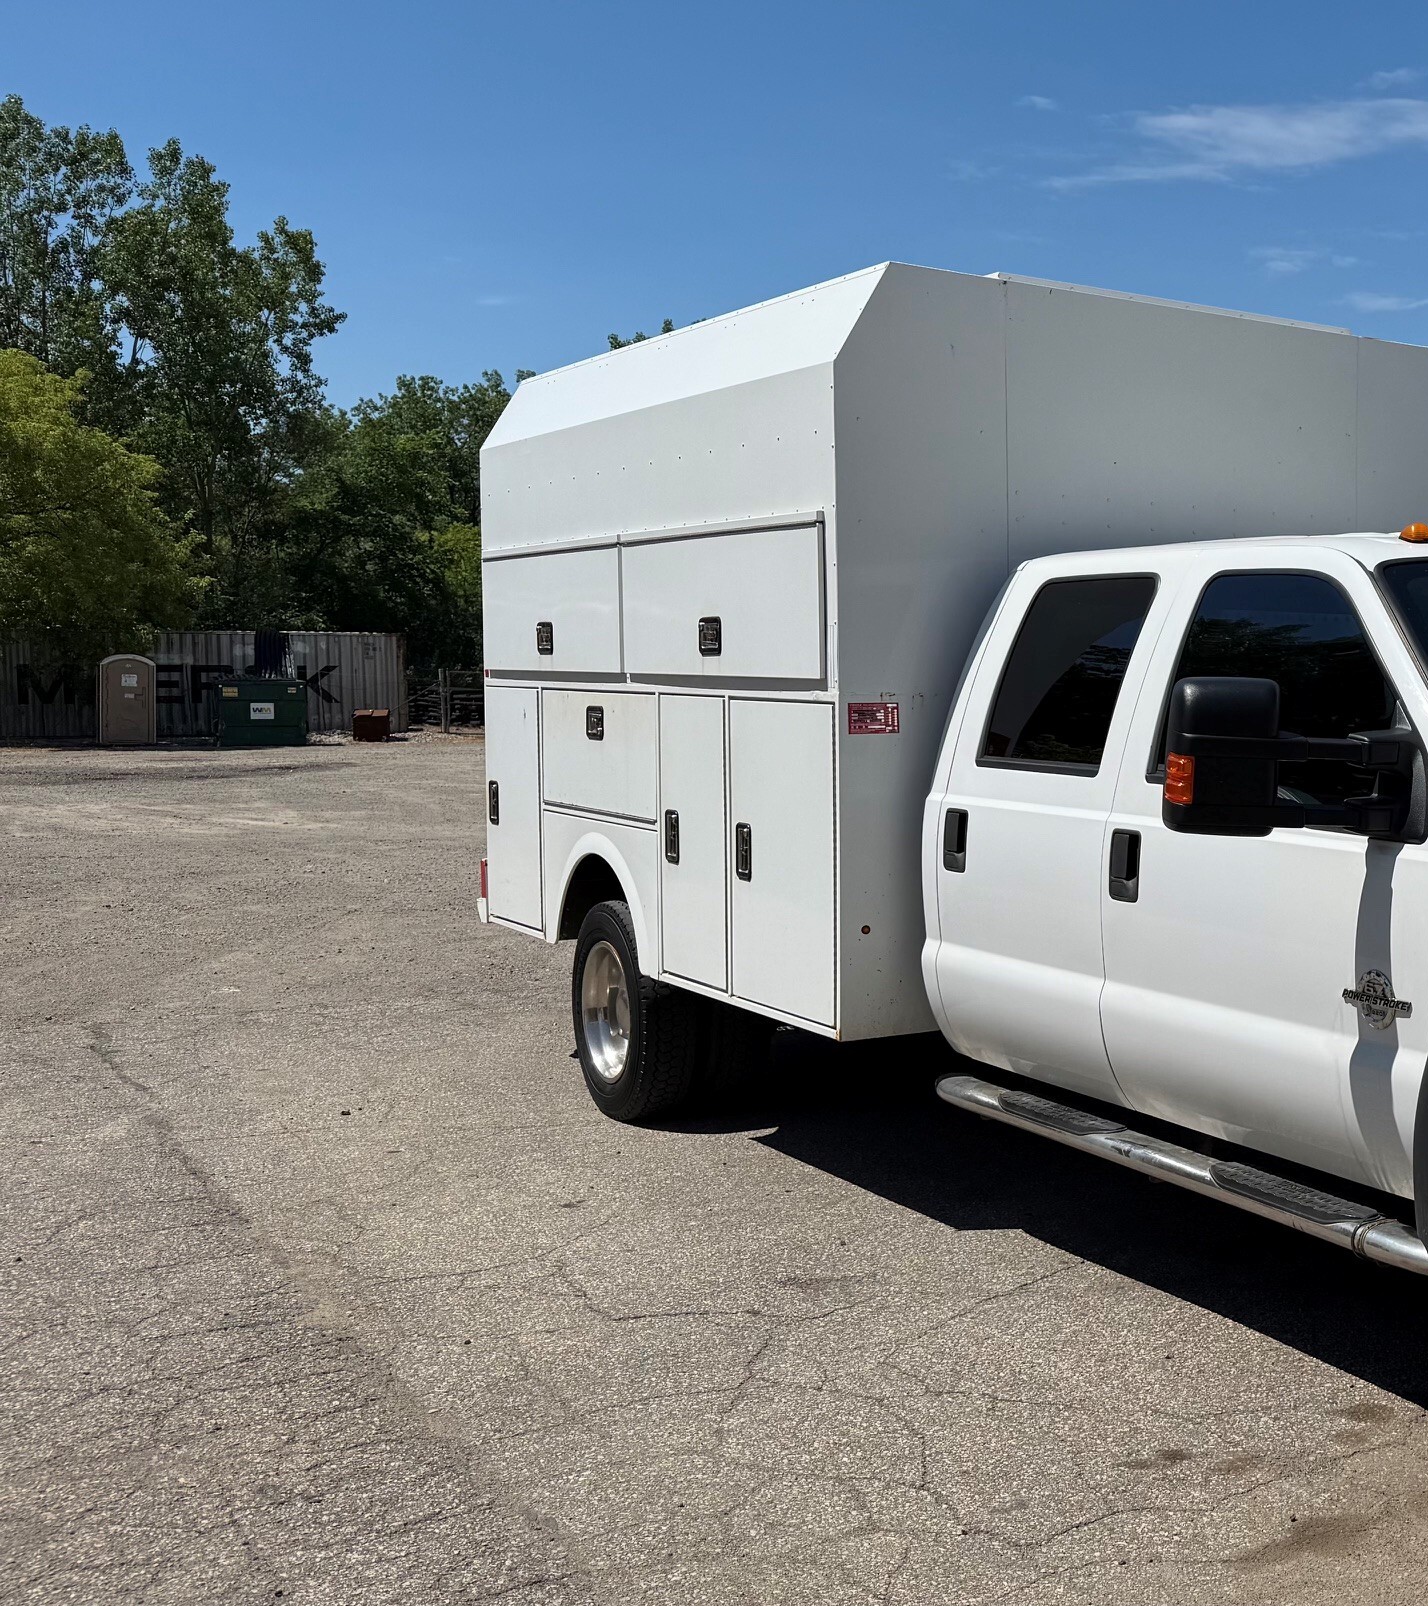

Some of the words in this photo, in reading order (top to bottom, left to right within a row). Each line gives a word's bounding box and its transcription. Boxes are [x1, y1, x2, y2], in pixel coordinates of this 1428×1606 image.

[17, 664, 341, 704] MERK
[1342, 988, 1371, 1004] POWER
[1371, 996, 1412, 1012] STROKE
